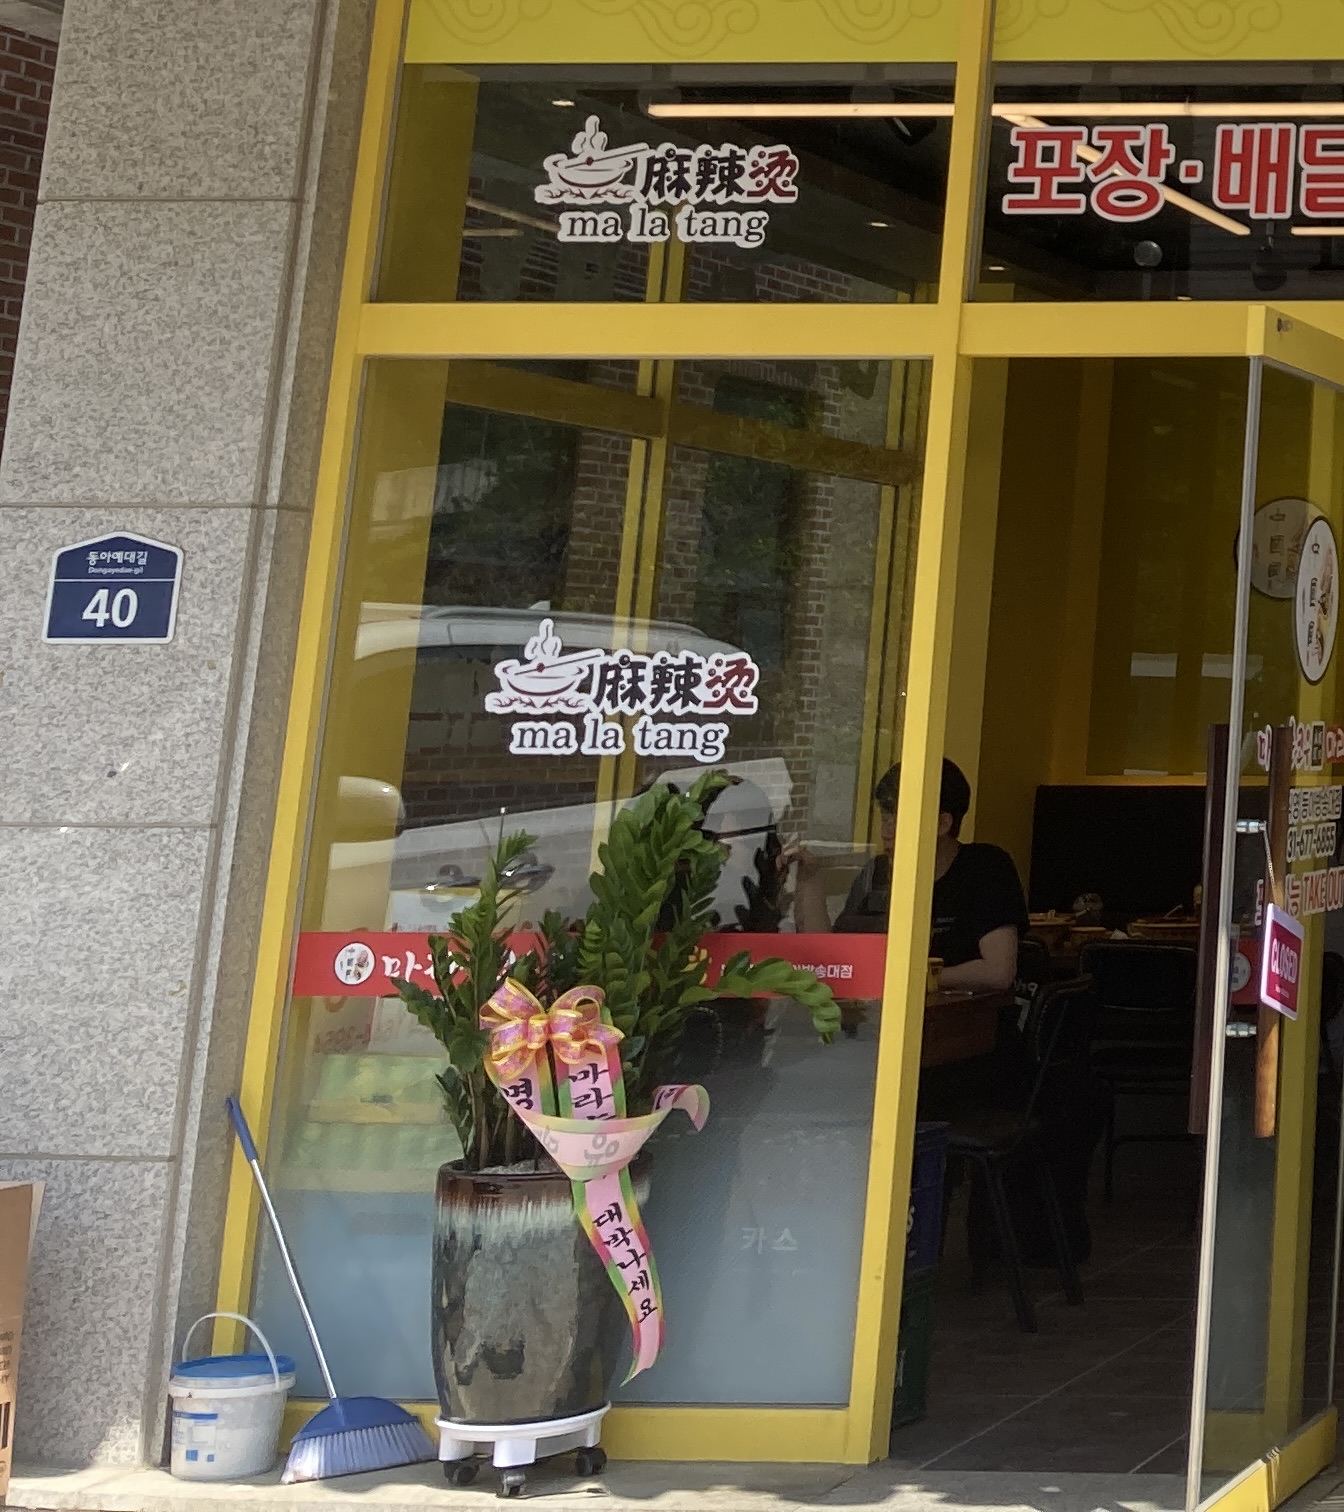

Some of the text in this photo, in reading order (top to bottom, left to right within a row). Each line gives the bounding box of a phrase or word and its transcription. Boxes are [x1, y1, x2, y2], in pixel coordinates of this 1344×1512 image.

[567, 207, 769, 243] ma la tang
[82, 588, 138, 628] 40
[516, 718, 725, 758] ma la tang
[1303, 871, 1327, 912] TAKE
[1271, 937, 1299, 984] CLOSED
